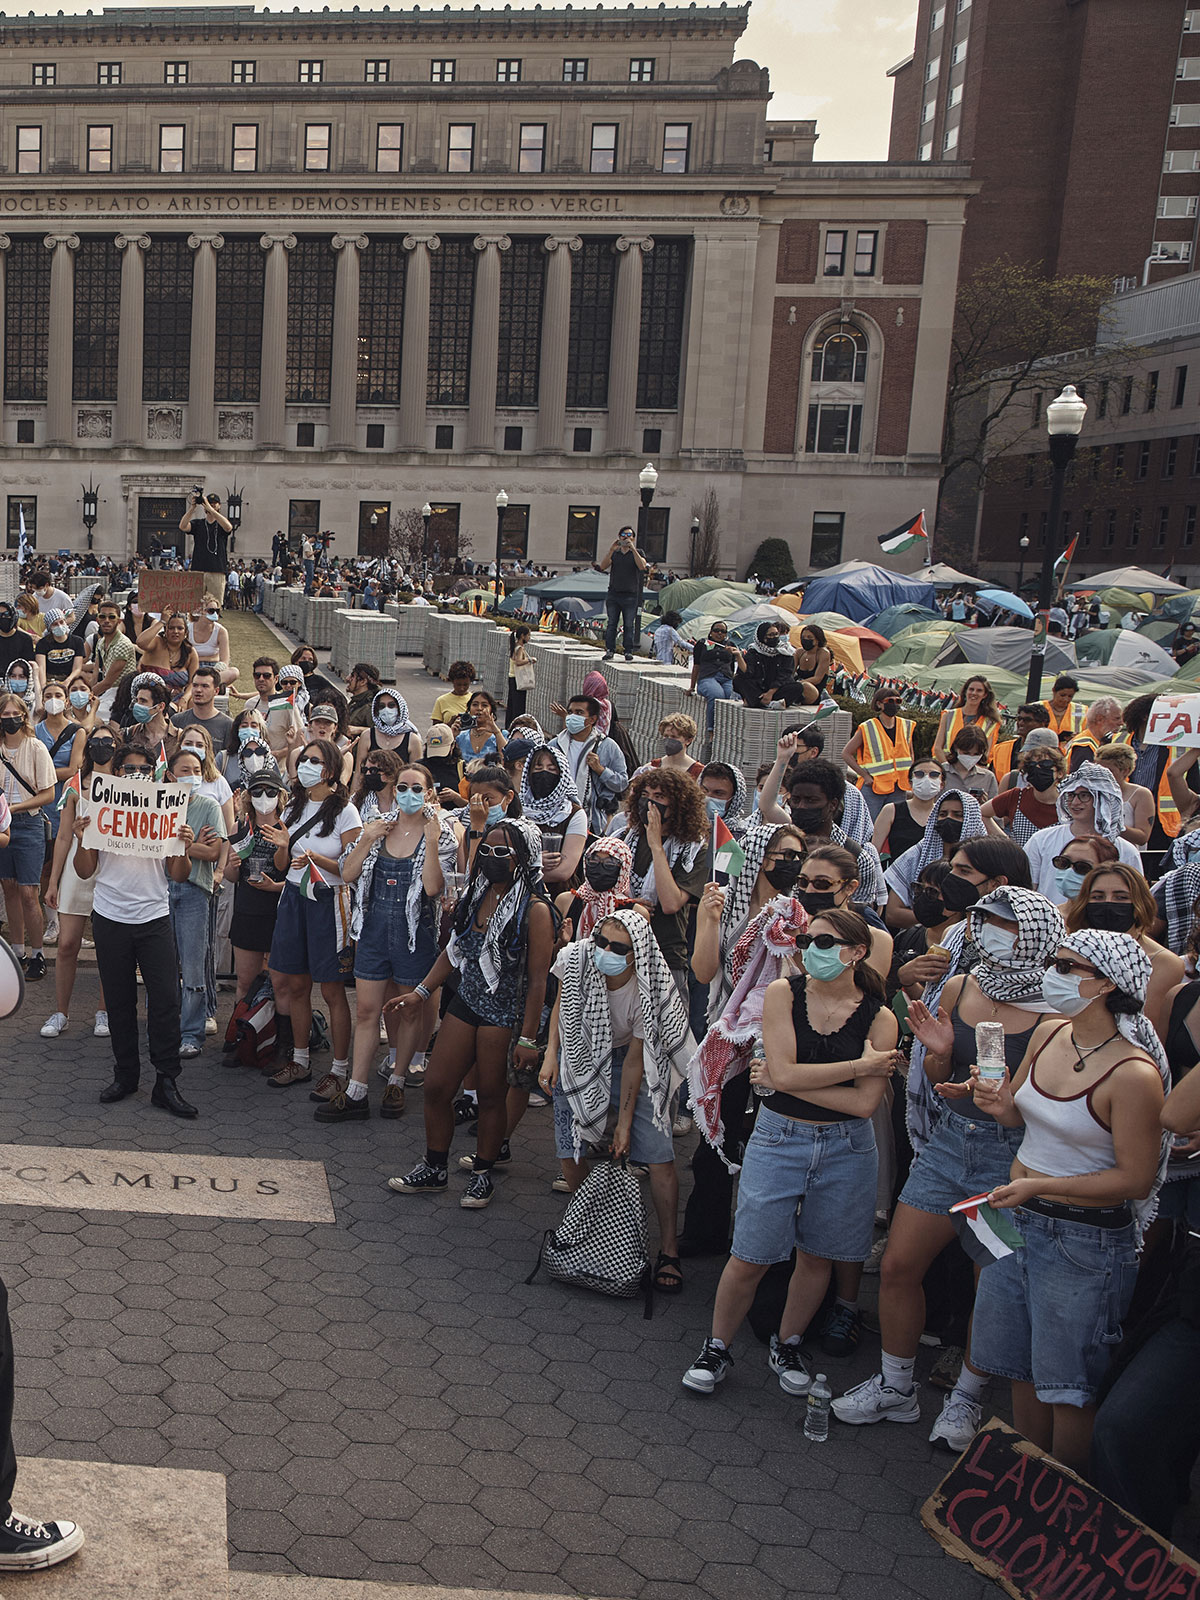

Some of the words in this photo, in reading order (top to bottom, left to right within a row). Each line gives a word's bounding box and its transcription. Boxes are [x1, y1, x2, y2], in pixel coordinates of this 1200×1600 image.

[85, 197, 150, 211] PLATO
[167, 197, 277, 212] ARISTOTLE
[291, 197, 442, 212] DEMOSTHENES
[457, 197, 534, 212] CICERO
[550, 198, 624, 213] VERGIL
[142, 574, 203, 590] COLUMBIA
[91, 776, 149, 808] Columbia
[156, 789, 187, 810] Funds
[97, 806, 179, 841] GENOCIDE
[14, 1165, 280, 1196] CAMPUS
[963, 1434, 1104, 1555] LAURA
